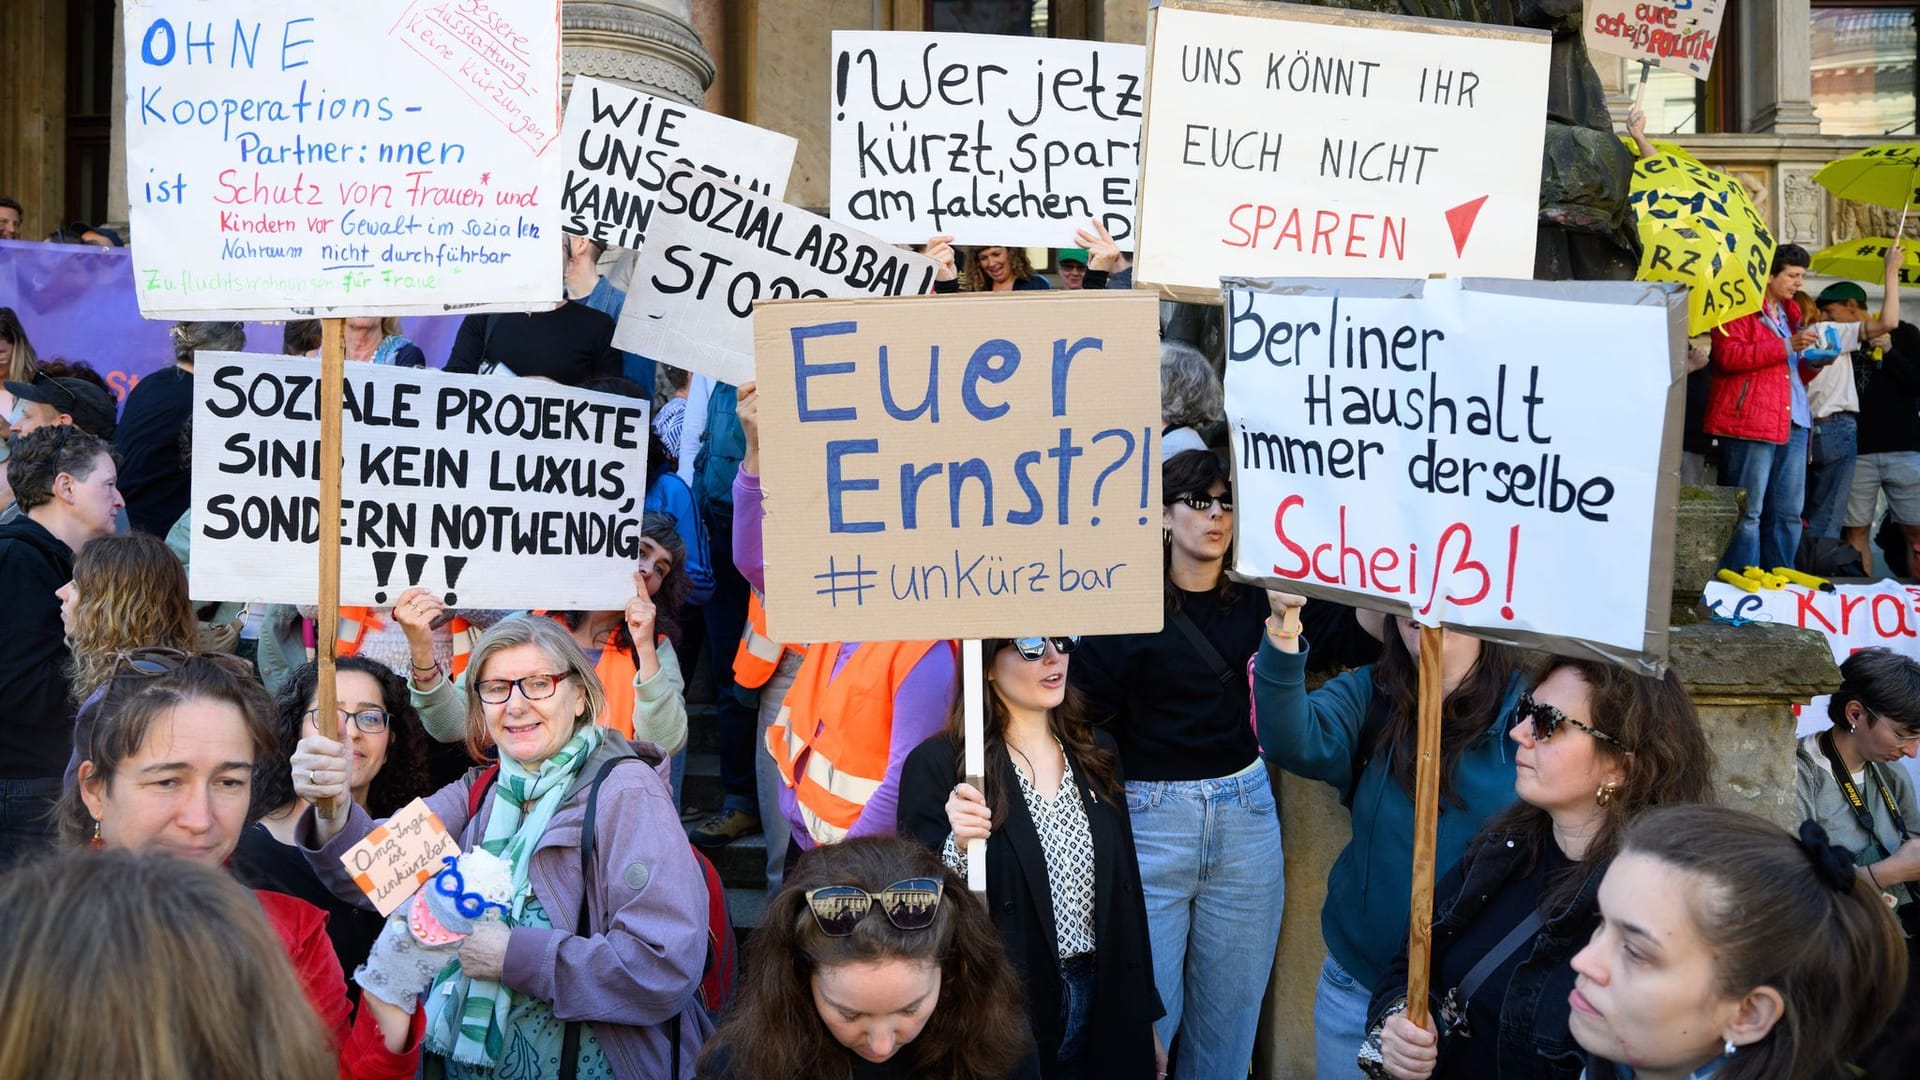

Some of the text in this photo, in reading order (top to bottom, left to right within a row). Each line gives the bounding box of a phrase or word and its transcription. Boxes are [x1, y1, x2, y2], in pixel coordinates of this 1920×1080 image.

[141, 17, 314, 71] OHNE
[1008, 51, 1142, 126] jetz
[1182, 45, 1480, 108] UNS KÖNNT IHR
[858, 120, 1003, 183] kürzt,
[1183, 124, 1439, 185] EUCH NICHT
[145, 169, 187, 204] ist
[214, 169, 324, 206] Schutz
[339, 180, 392, 208] von
[496, 187, 538, 207] und
[561, 170, 654, 232] KANN
[848, 188, 915, 222] am
[928, 175, 1093, 231] falschen
[220, 211, 295, 234] Kindern
[308, 217, 334, 234] vor
[341, 210, 422, 236] Gewalt
[427, 216, 454, 236] im
[222, 243, 511, 266] Nahraum nicht durchführbar
[1221, 203, 1406, 261] SPAREN
[343, 270, 371, 293] für
[651, 244, 828, 319] STO
[1228, 288, 1445, 371] Berliner
[790, 321, 1104, 423] Euer
[1304, 363, 1552, 444] Haushalt
[205, 365, 642, 450] SOZIALE PROJEKTE
[360, 444, 469, 489] KEIN
[489, 450, 635, 514] LUXUS,
[826, 427, 1151, 534] Ernst?!
[1240, 424, 1614, 521] immer derselbe
[202, 493, 640, 560] SONDERN NOTWENDIG
[1273, 493, 1521, 621] Scheiß!
[352, 838, 400, 872] Oma
[388, 848, 407, 867] ist
